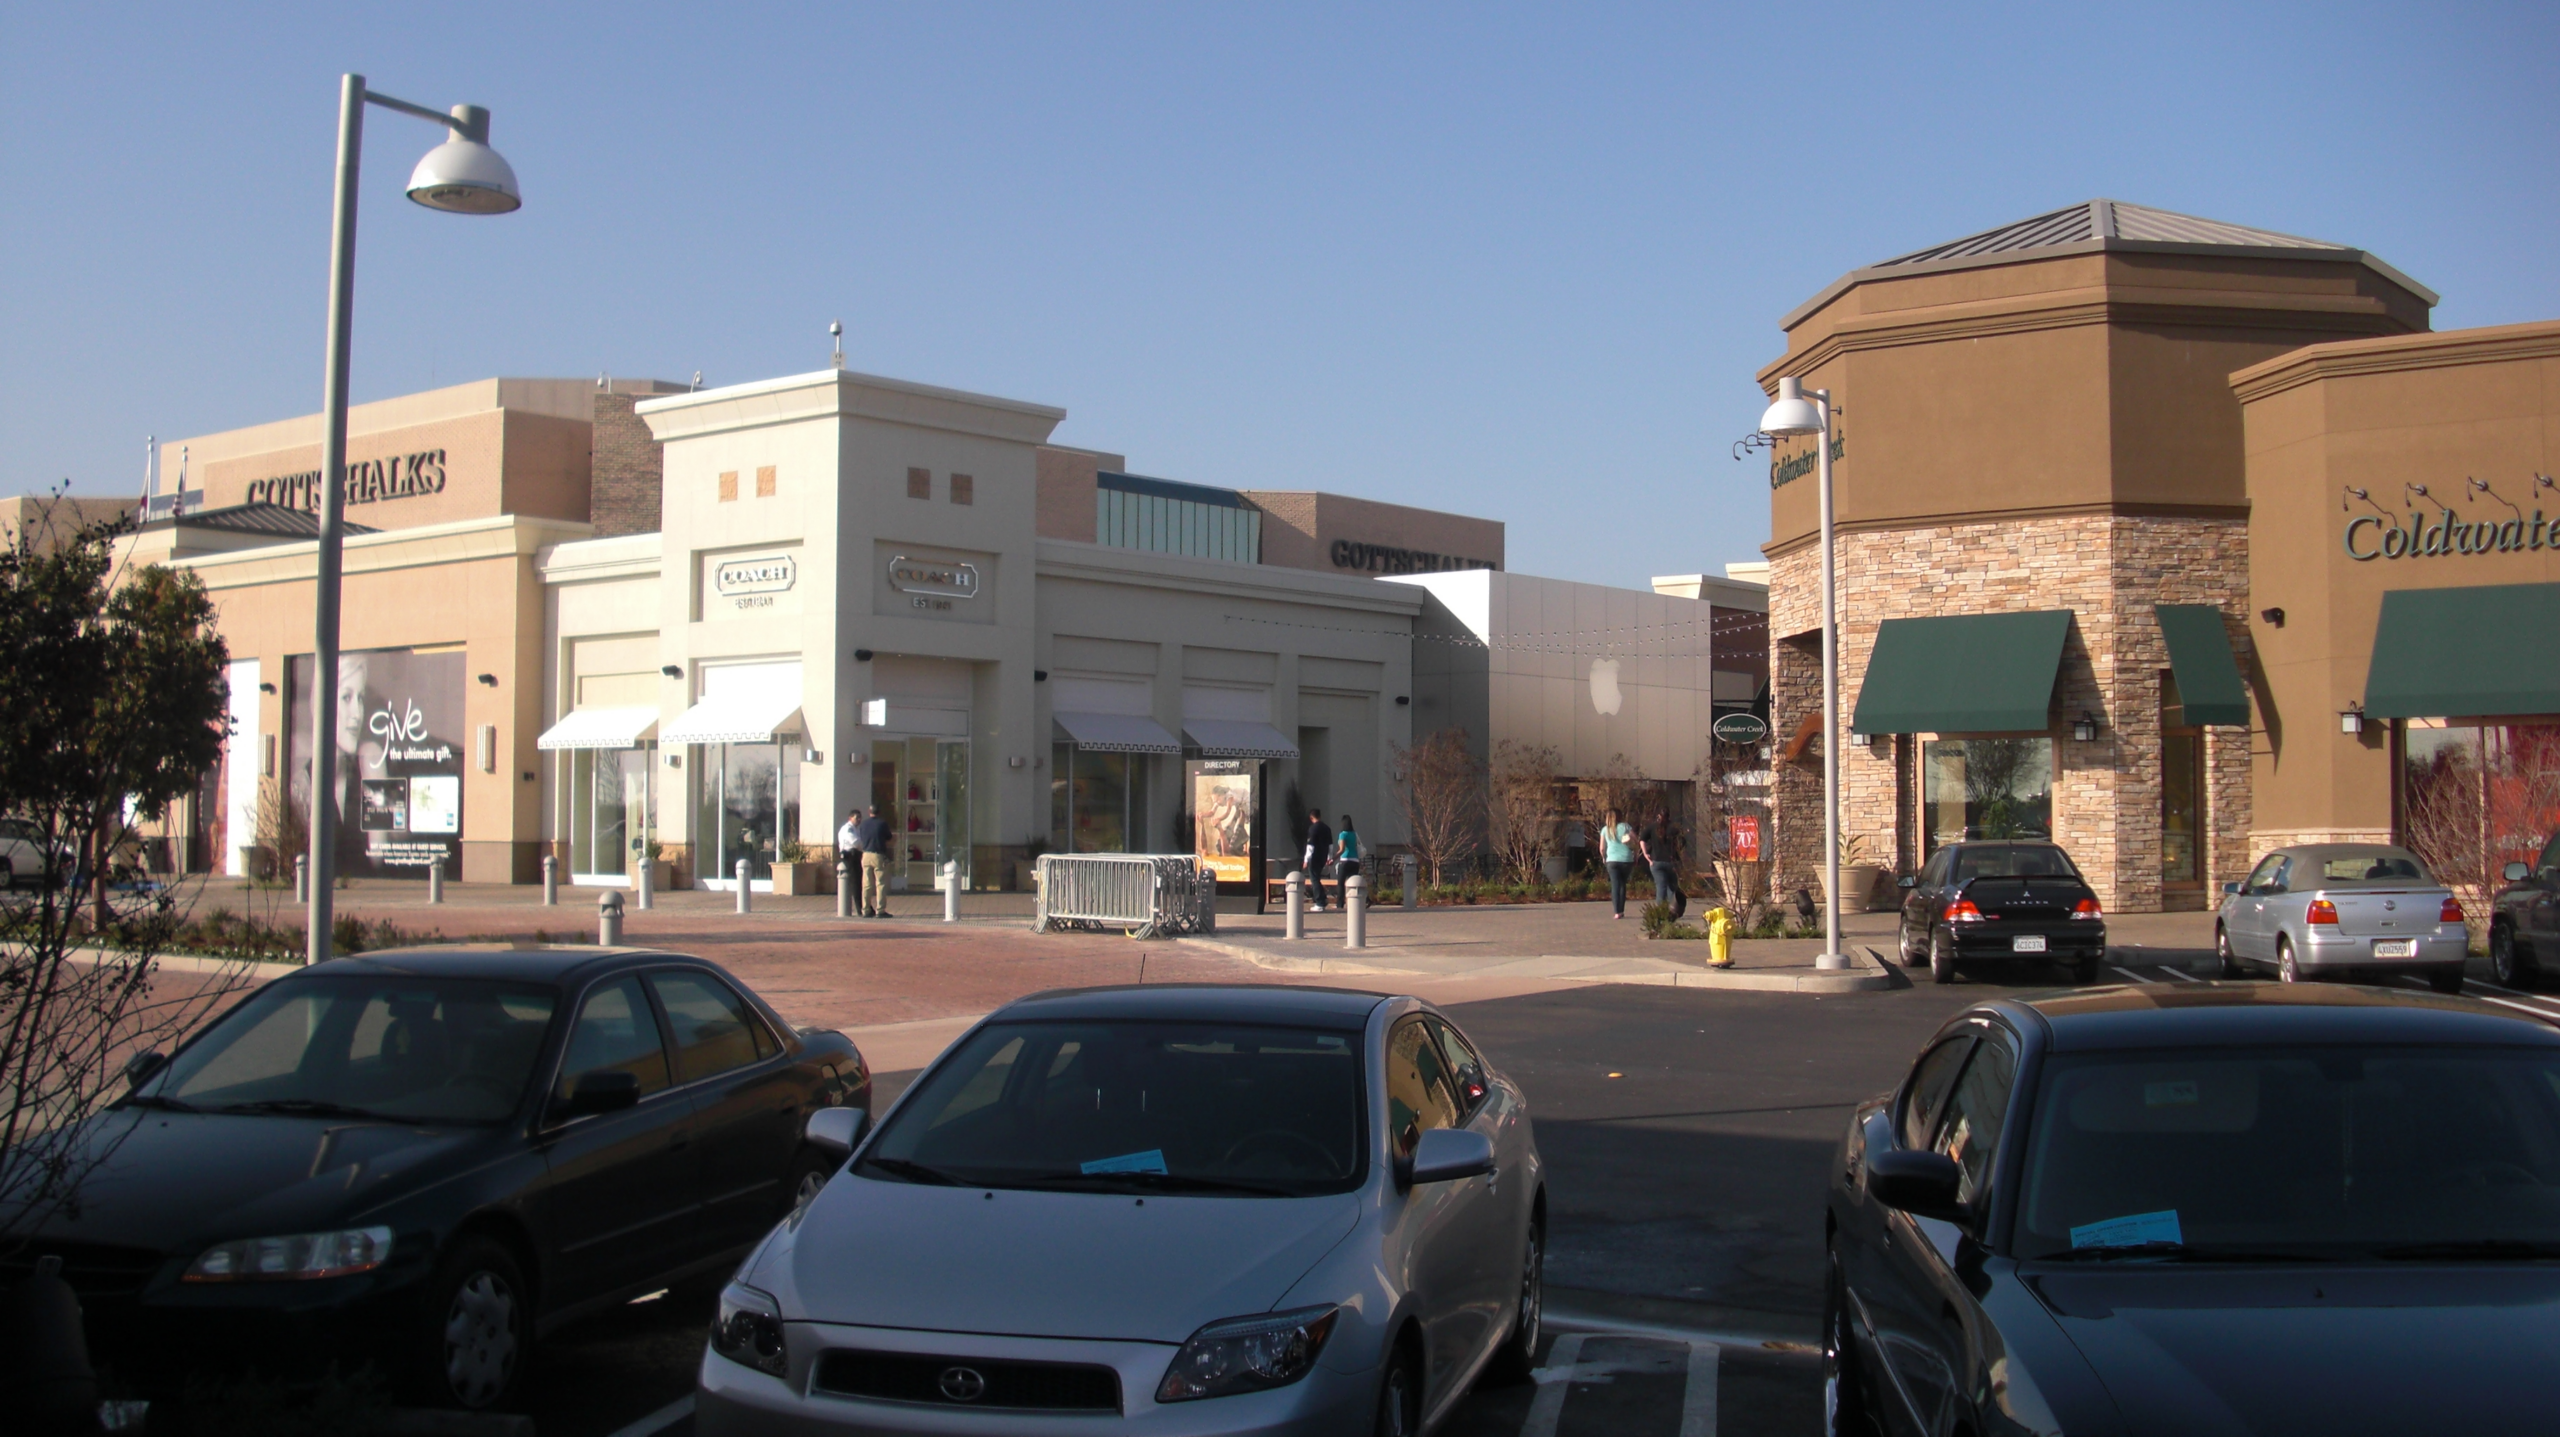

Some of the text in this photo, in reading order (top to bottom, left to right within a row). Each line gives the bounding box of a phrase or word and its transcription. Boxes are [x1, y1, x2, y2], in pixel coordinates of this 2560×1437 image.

[721, 566, 788, 585] COACH
[897, 569, 969, 586] COACH
[369, 697, 428, 769] give
[1716, 725, 1764, 733] Coldwater Creek
[389, 746, 402, 760] the
[403, 746, 435, 760] ultimate
[1204, 761, 1240, 769] DIRECTORY
